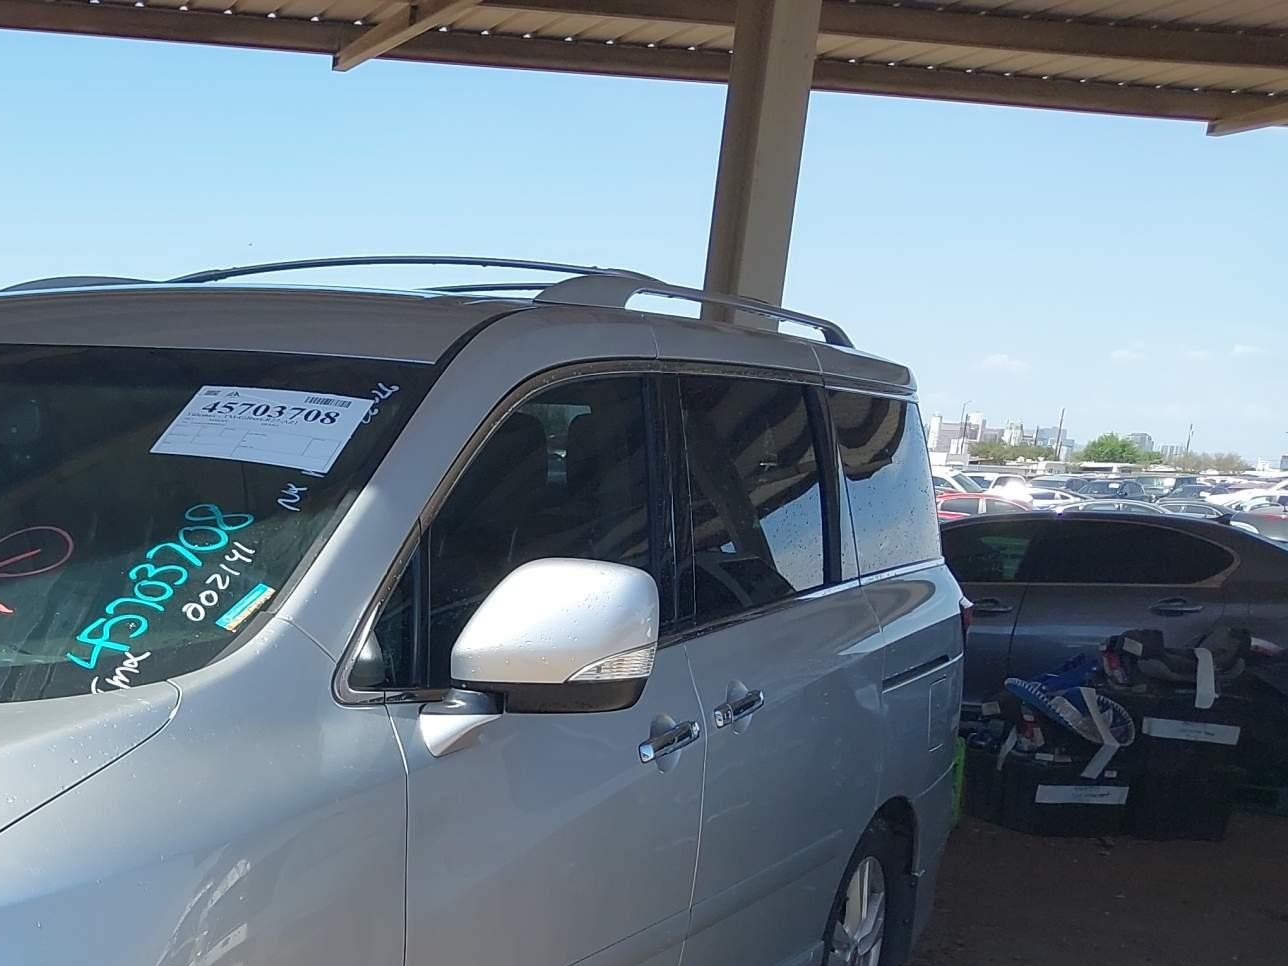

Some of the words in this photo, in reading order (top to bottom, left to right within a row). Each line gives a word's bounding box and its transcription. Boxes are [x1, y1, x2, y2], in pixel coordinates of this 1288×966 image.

[201, 400, 342, 426] 45703708
[65, 503, 256, 672] 45703708
[180, 540, 257, 623] 002141
